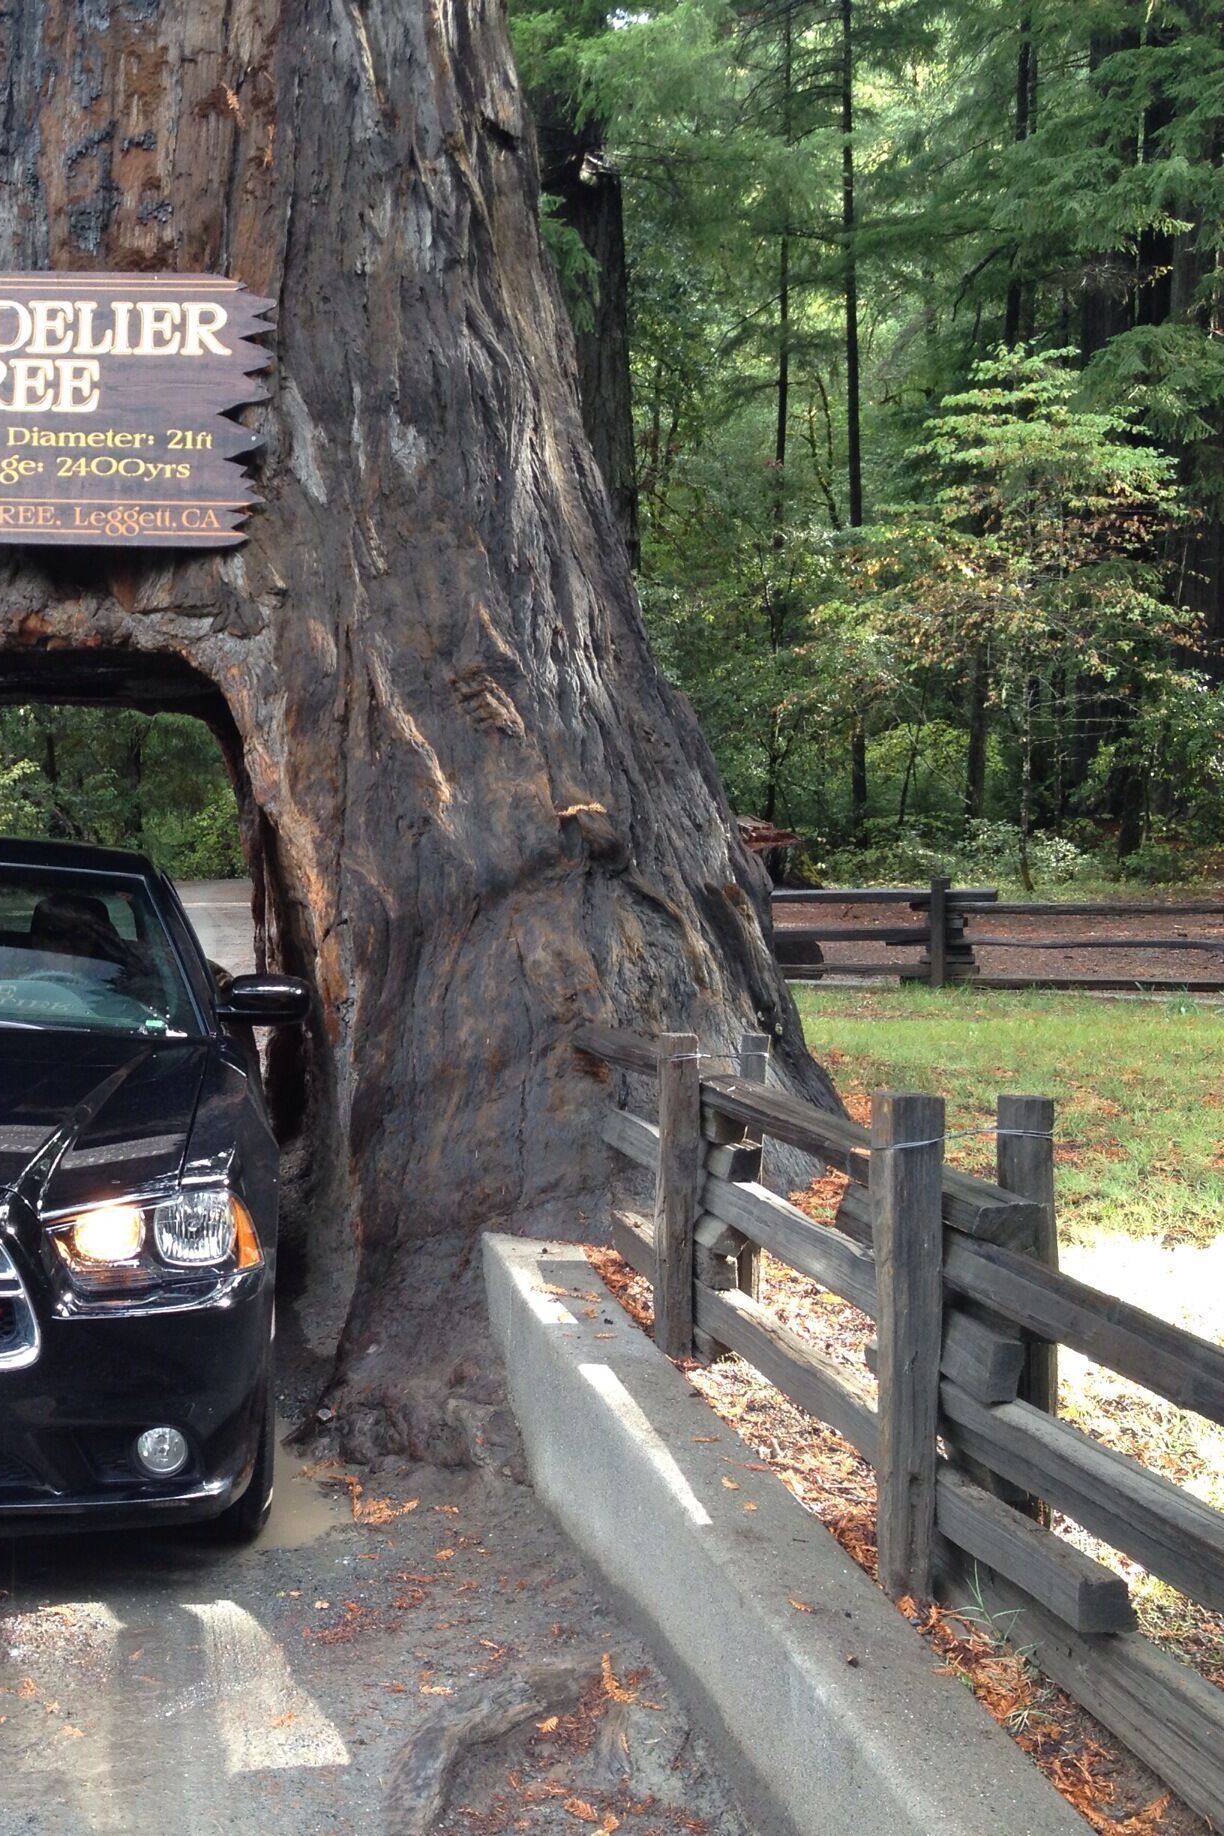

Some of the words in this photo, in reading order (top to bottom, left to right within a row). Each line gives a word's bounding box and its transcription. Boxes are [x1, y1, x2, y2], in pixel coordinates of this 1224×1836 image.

[6, 426, 155, 448] Diameter:
[167, 429, 213, 450] 21ft
[56, 456, 191, 482] 2400yrs
[181, 508, 221, 529] CA
